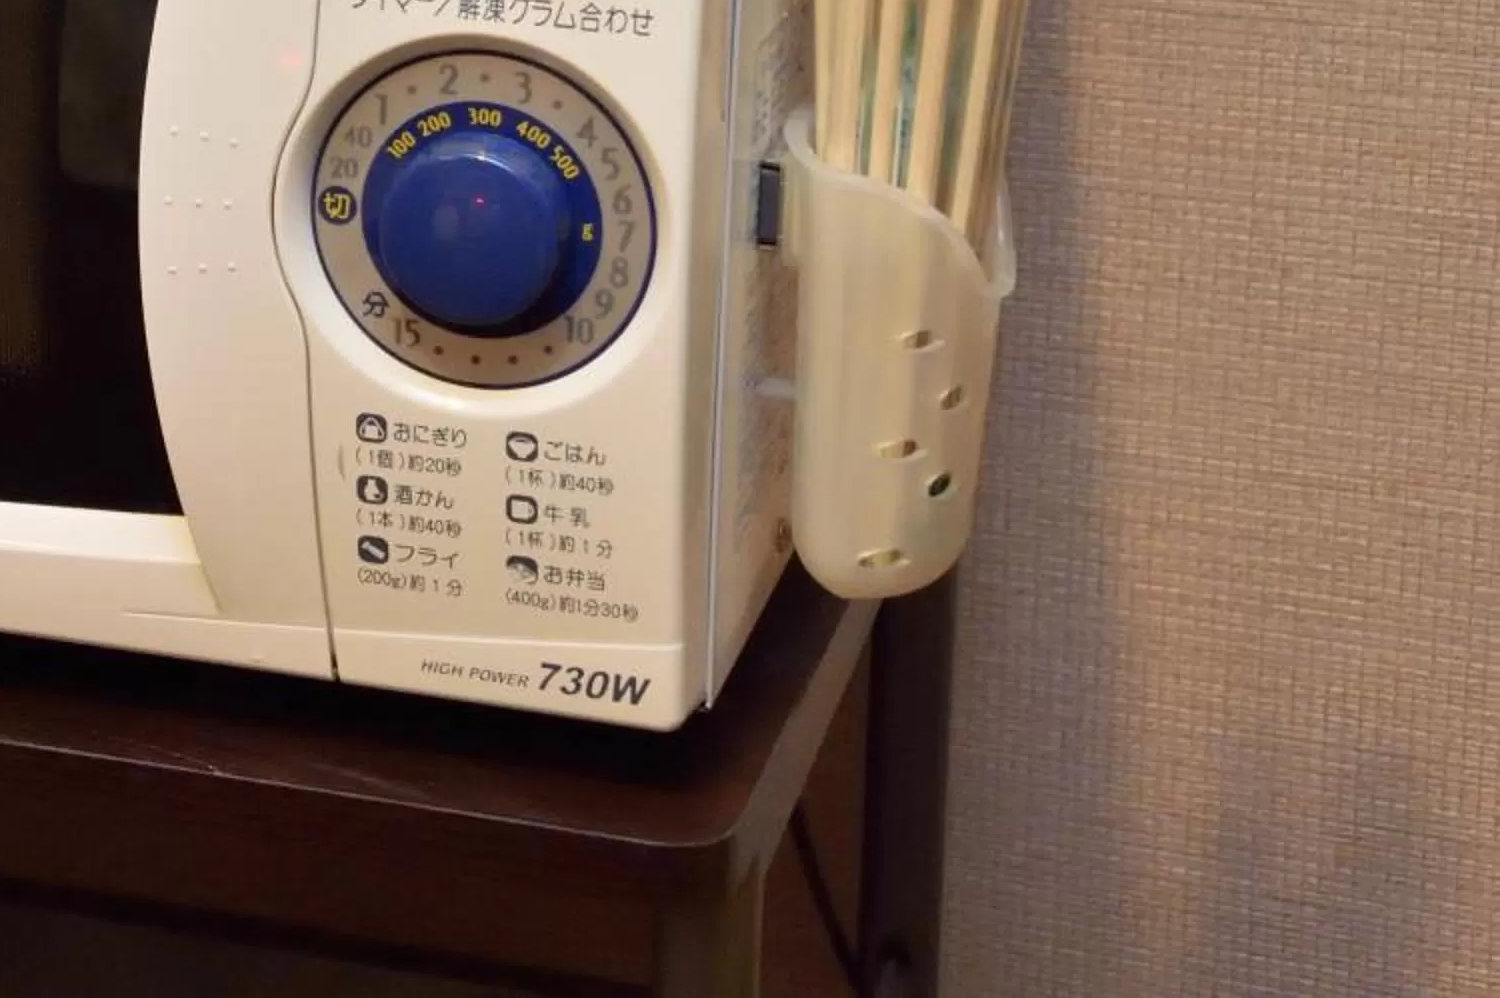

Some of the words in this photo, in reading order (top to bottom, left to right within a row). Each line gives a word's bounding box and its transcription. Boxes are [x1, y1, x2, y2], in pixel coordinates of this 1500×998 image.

[438, 64, 460, 95] 2
[515, 71, 533, 104] 3
[374, 94, 389, 126] 1
[344, 126, 372, 148] 40
[387, 131, 417, 160] 100
[417, 112, 452, 138] 200
[468, 107, 502, 127] 300
[516, 120, 552, 150] 400
[549, 144, 581, 180] 500
[577, 117, 599, 148] 4
[329, 157, 358, 178] 20
[602, 148, 622, 181] 5
[323, 192, 351, 220] 切
[612, 183, 632, 215] 6
[617, 219, 636, 253] 7
[609, 256, 629, 289] 8
[363, 291, 390, 319] 分
[595, 290, 615, 319] 9
[392, 318, 421, 347] 15
[564, 315, 595, 345] 10
[393, 422, 467, 449] おにぎり
[543, 441, 607, 466] ごはん
[394, 484, 454, 510] 酒かん
[543, 505, 591, 528] 牛乳
[394, 543, 459, 570] フライ
[543, 565, 605, 591] お弁当
[420, 658, 463, 677] HIGH
[468, 667, 530, 689] POWER
[536, 660, 652, 706] 730W
